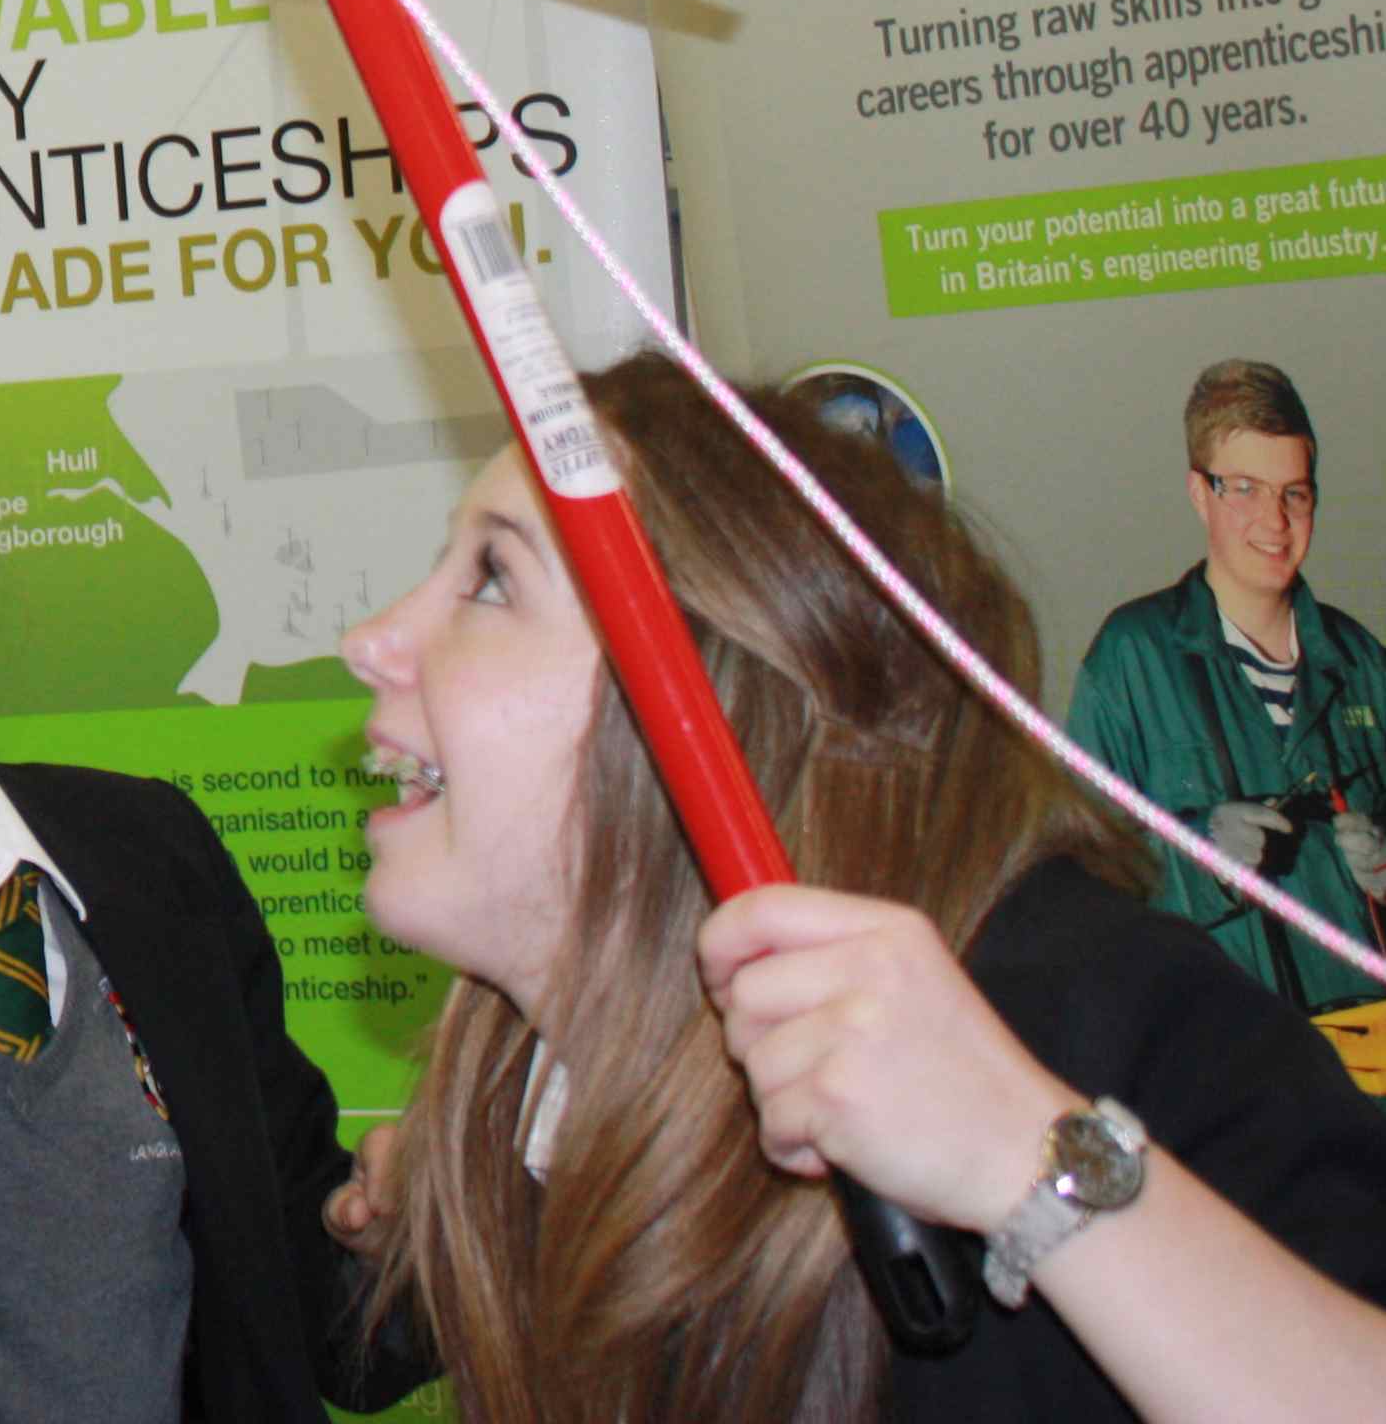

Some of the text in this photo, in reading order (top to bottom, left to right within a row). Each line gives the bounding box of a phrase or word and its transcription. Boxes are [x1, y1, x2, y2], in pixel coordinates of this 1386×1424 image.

[875, 8, 1021, 58] Turning
[1033, 0, 1097, 38] raw
[856, 74, 983, 119] careers
[993, 46, 1134, 99] through
[983, 91, 1308, 160] for over 40 years.
[906, 224, 968, 254] Turn
[977, 220, 1035, 251] your
[1044, 201, 1163, 245] potential
[1172, 195, 1223, 226] into
[1231, 199, 1246, 220] a
[1255, 186, 1321, 224] great
[178, 222, 332, 297] FOR
[940, 268, 967, 295] in
[977, 253, 1094, 292] Britain's
[1103, 237, 1262, 282] engineering
[46, 447, 98, 474] Hull
[202, 764, 301, 793] second
[309, 765, 336, 788] to
[208, 807, 347, 837] ganisation
[249, 847, 372, 874] would be
[304, 931, 372, 956] meet
[284, 972, 428, 1006] nticeship."
